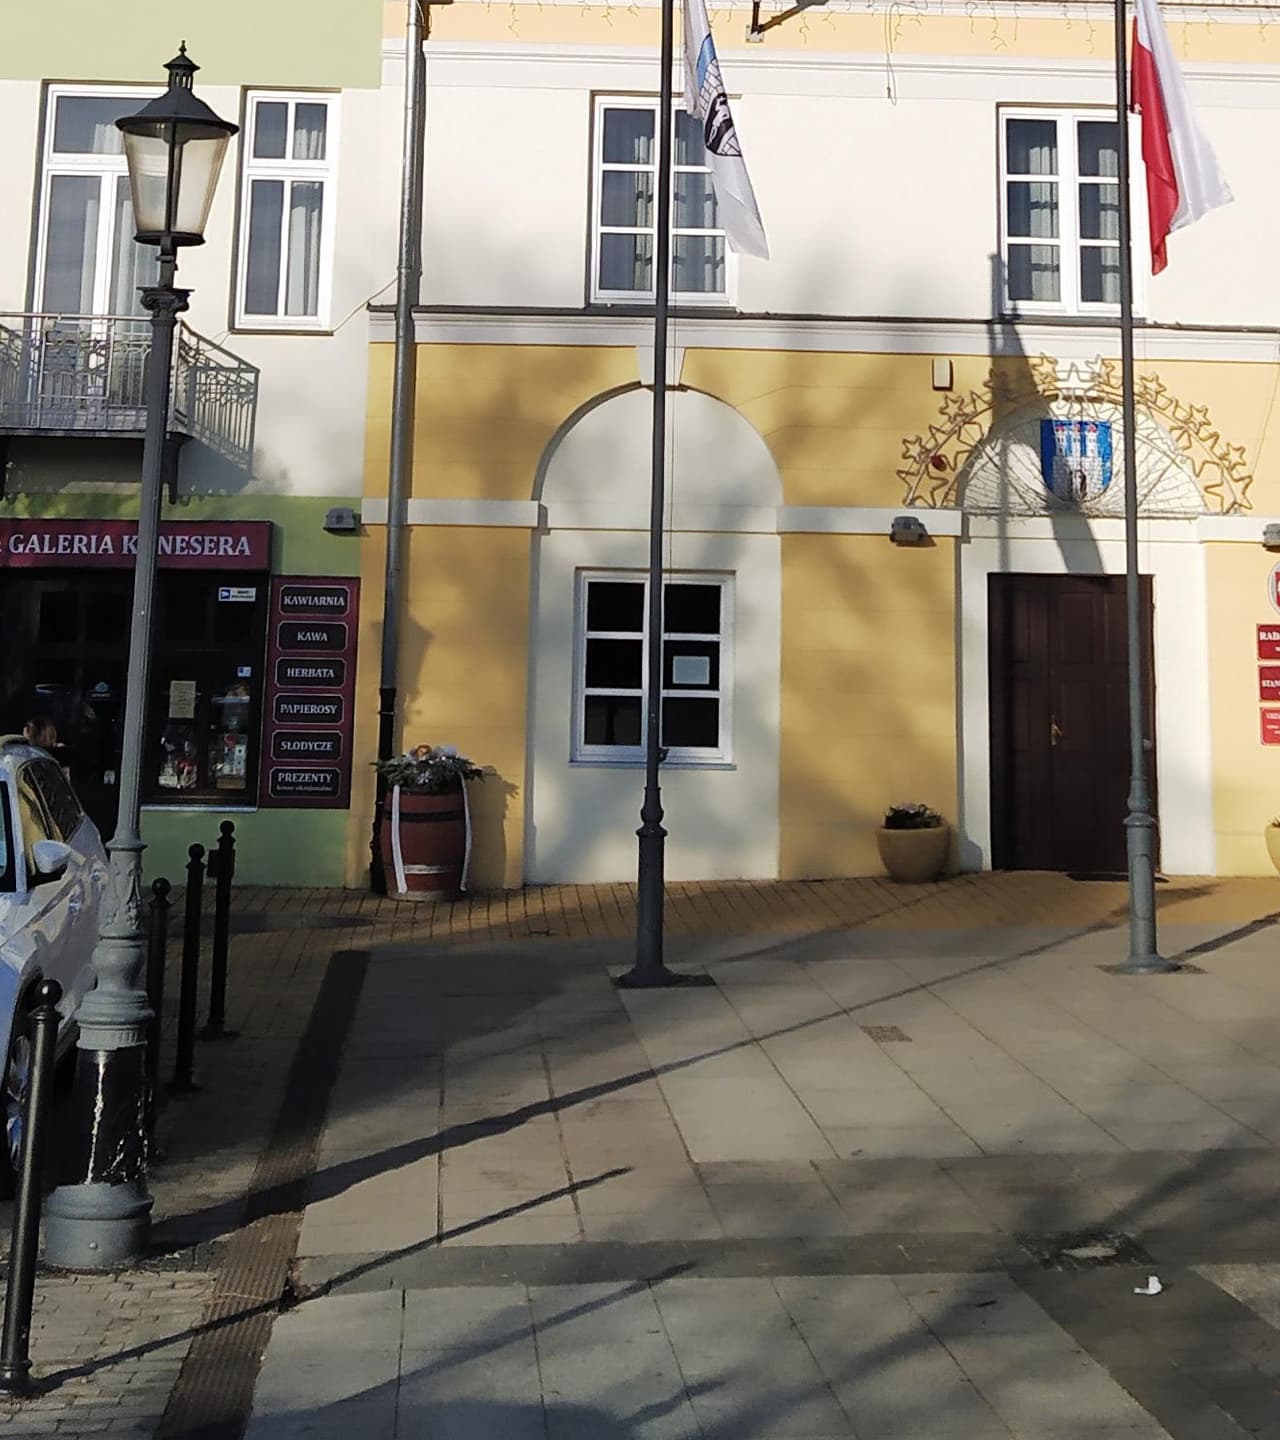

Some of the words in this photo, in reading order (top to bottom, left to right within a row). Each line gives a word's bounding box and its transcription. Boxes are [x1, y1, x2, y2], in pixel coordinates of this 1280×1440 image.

[9, 534, 114, 555] GALERIA
[118, 535, 251, 556] KNESERA
[283, 595, 345, 607] KAWIARNIA
[297, 631, 328, 642] KAWA
[287, 667, 335, 678] HERBATA
[280, 704, 338, 714] PAPIEROSY
[280, 741, 333, 751] SŁODYCZE
[278, 772, 333, 783] PREZENTY
